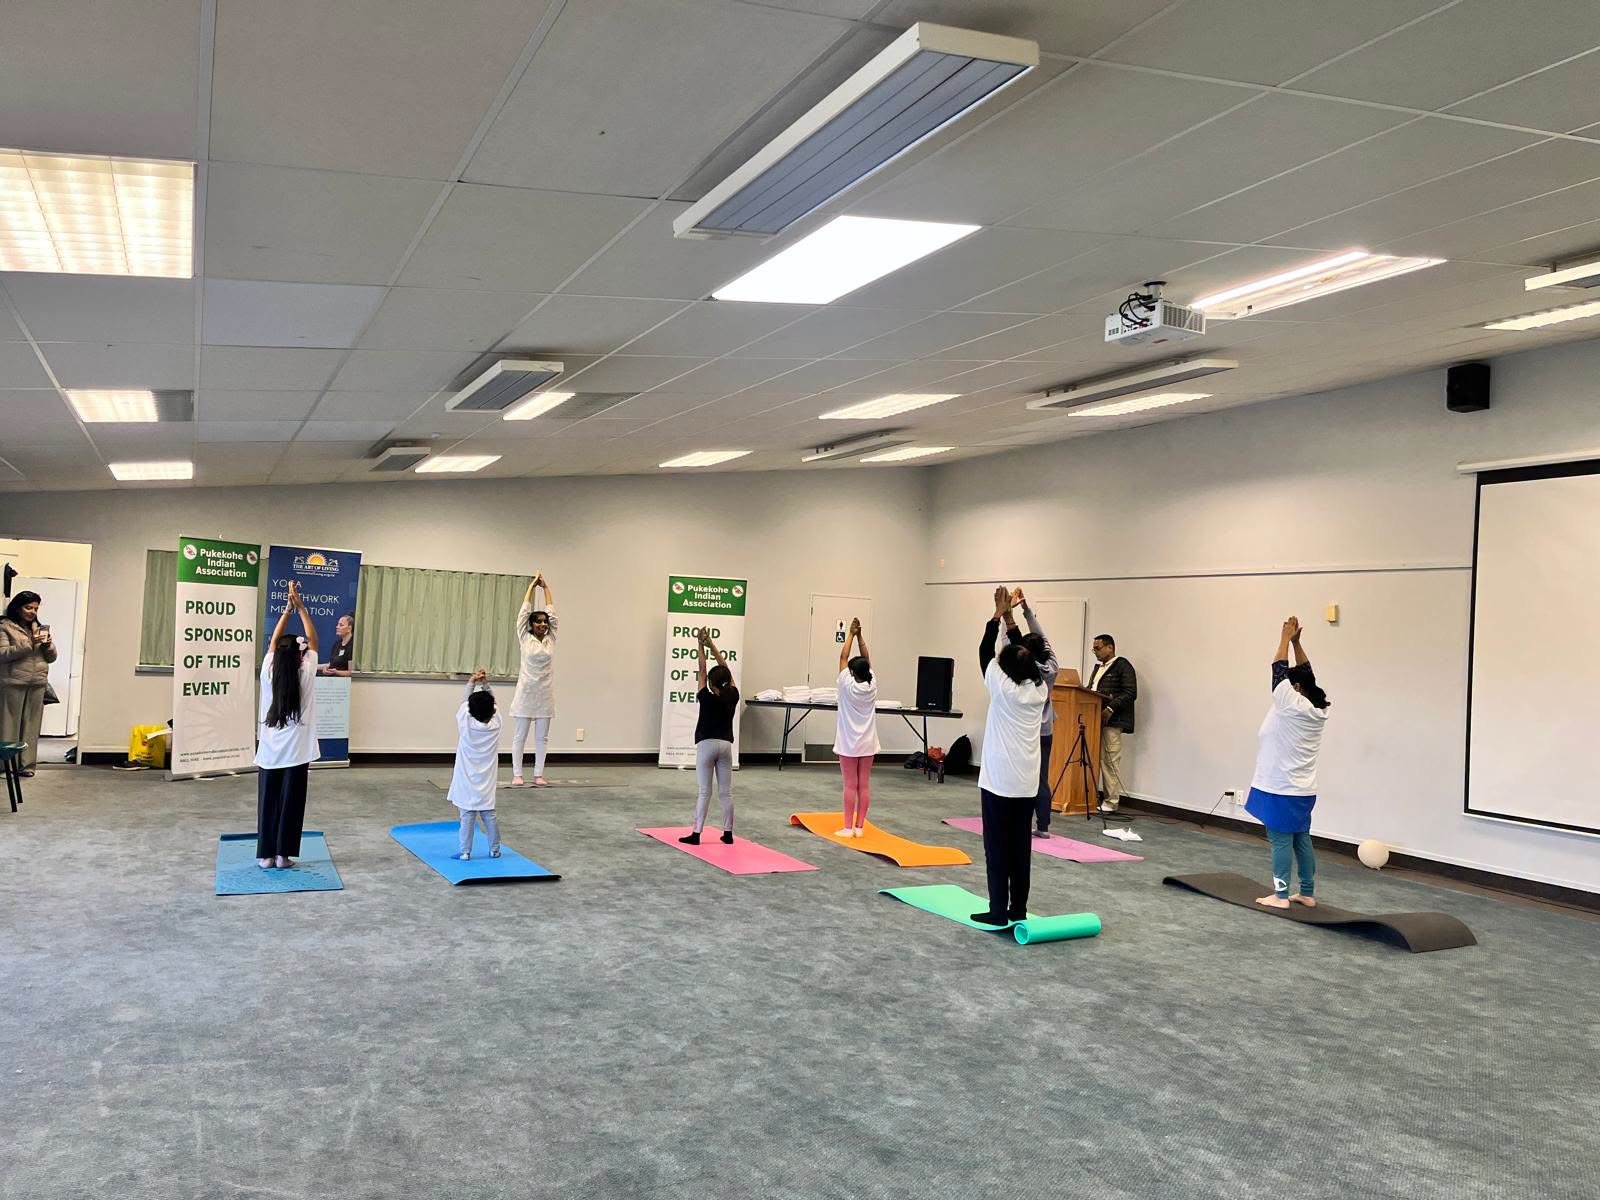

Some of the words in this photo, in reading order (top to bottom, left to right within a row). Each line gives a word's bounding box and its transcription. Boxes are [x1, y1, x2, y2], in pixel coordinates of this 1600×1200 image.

[200, 548, 244, 560] Pukekohe
[207, 558, 236, 568] Indian
[195, 566, 247, 578] Association
[272, 579, 302, 588] YOA
[687, 584, 729, 594] Pukekohe
[271, 592, 339, 603] BRETHWORK
[694, 592, 721, 601] Indian
[185, 600, 236, 616] PROUD
[682, 599, 732, 610] Association
[184, 628, 253, 642] SPONSOR
[184, 654, 203, 669] OF
[207, 654, 241, 668] THIS
[670, 670, 688, 681] OF
[182, 682, 230, 696] EVENT
[670, 692, 698, 702] EVE
